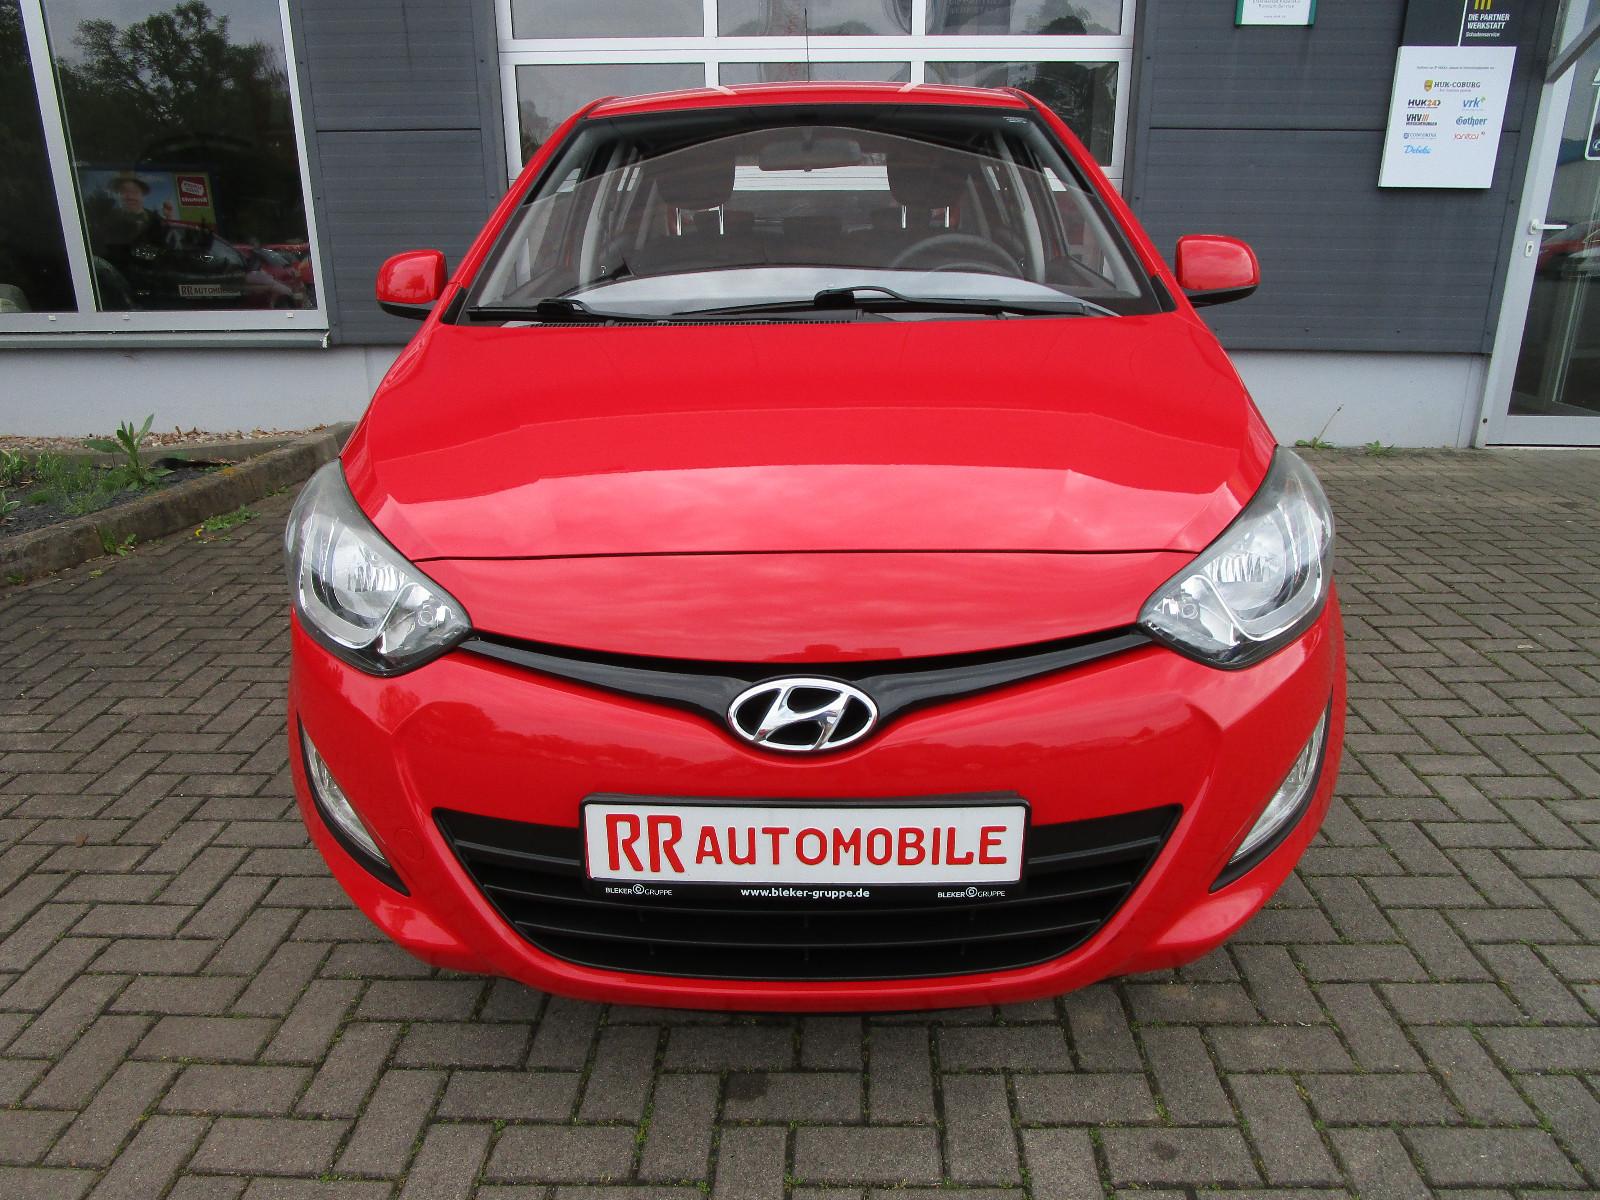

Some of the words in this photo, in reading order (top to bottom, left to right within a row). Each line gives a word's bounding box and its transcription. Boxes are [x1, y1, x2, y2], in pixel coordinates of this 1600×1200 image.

[1468, 13, 1479, 21] DIE
[1480, 13, 1510, 21] PARTNER
[1467, 22, 1506, 30] WERKSTATT
[1434, 81, 1481, 89] HUK-COBURG
[1463, 97, 1480, 108] vrk
[605, 813, 686, 873] RR
[695, 825, 1008, 866] AUTOMOBILE
[605, 886, 633, 895] BLEKER
[644, 888, 673, 897] GRUPPE
[740, 887, 870, 899] www.bleker-gruppe.de
[937, 890, 966, 899] BLEKER
[977, 889, 1006, 898] GRUPPE
